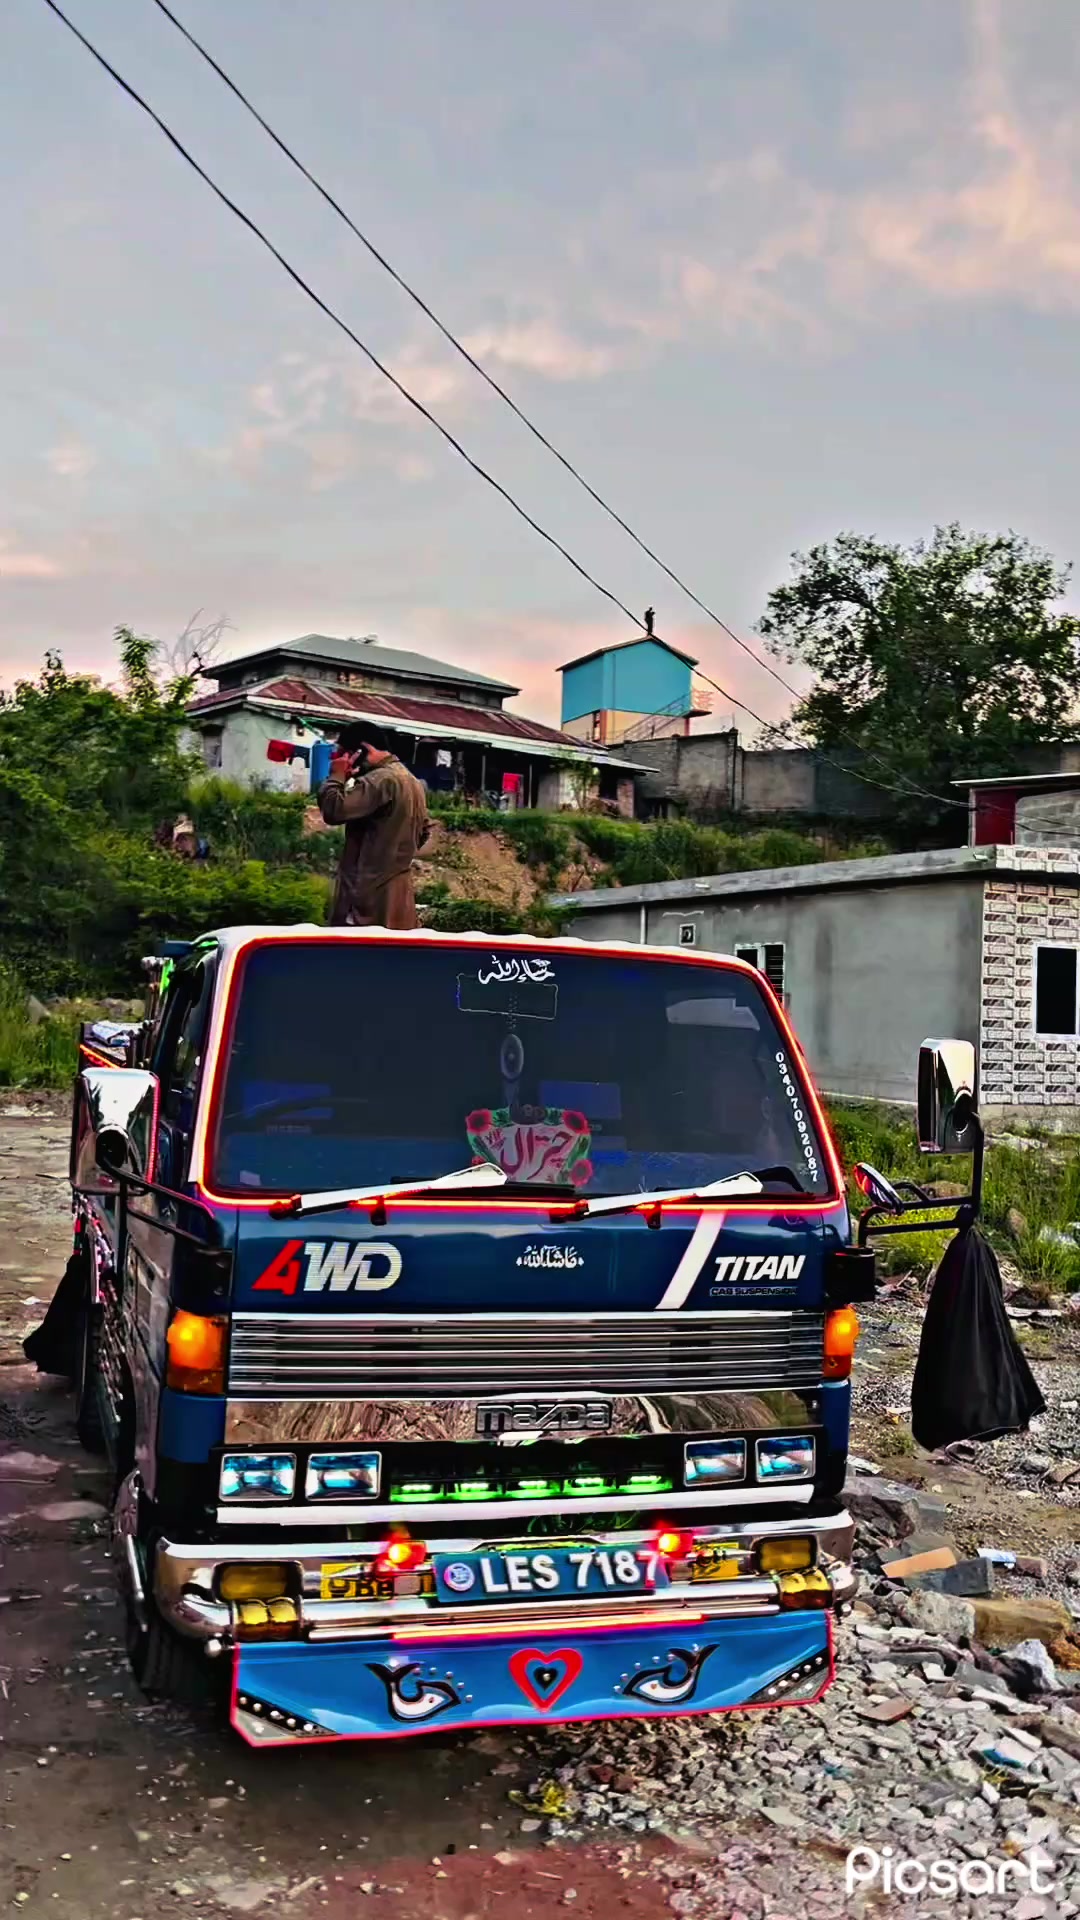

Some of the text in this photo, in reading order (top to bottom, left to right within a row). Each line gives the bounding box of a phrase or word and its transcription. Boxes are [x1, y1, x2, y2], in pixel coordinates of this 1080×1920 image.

[775, 1052, 819, 1182] 03407092087
[252, 1239, 403, 1296] 4WD
[714, 1254, 807, 1281] TITAN
[476, 1403, 611, 1431] mazda
[480, 1553, 560, 1593] LES
[569, 1549, 660, 1588] 7187
